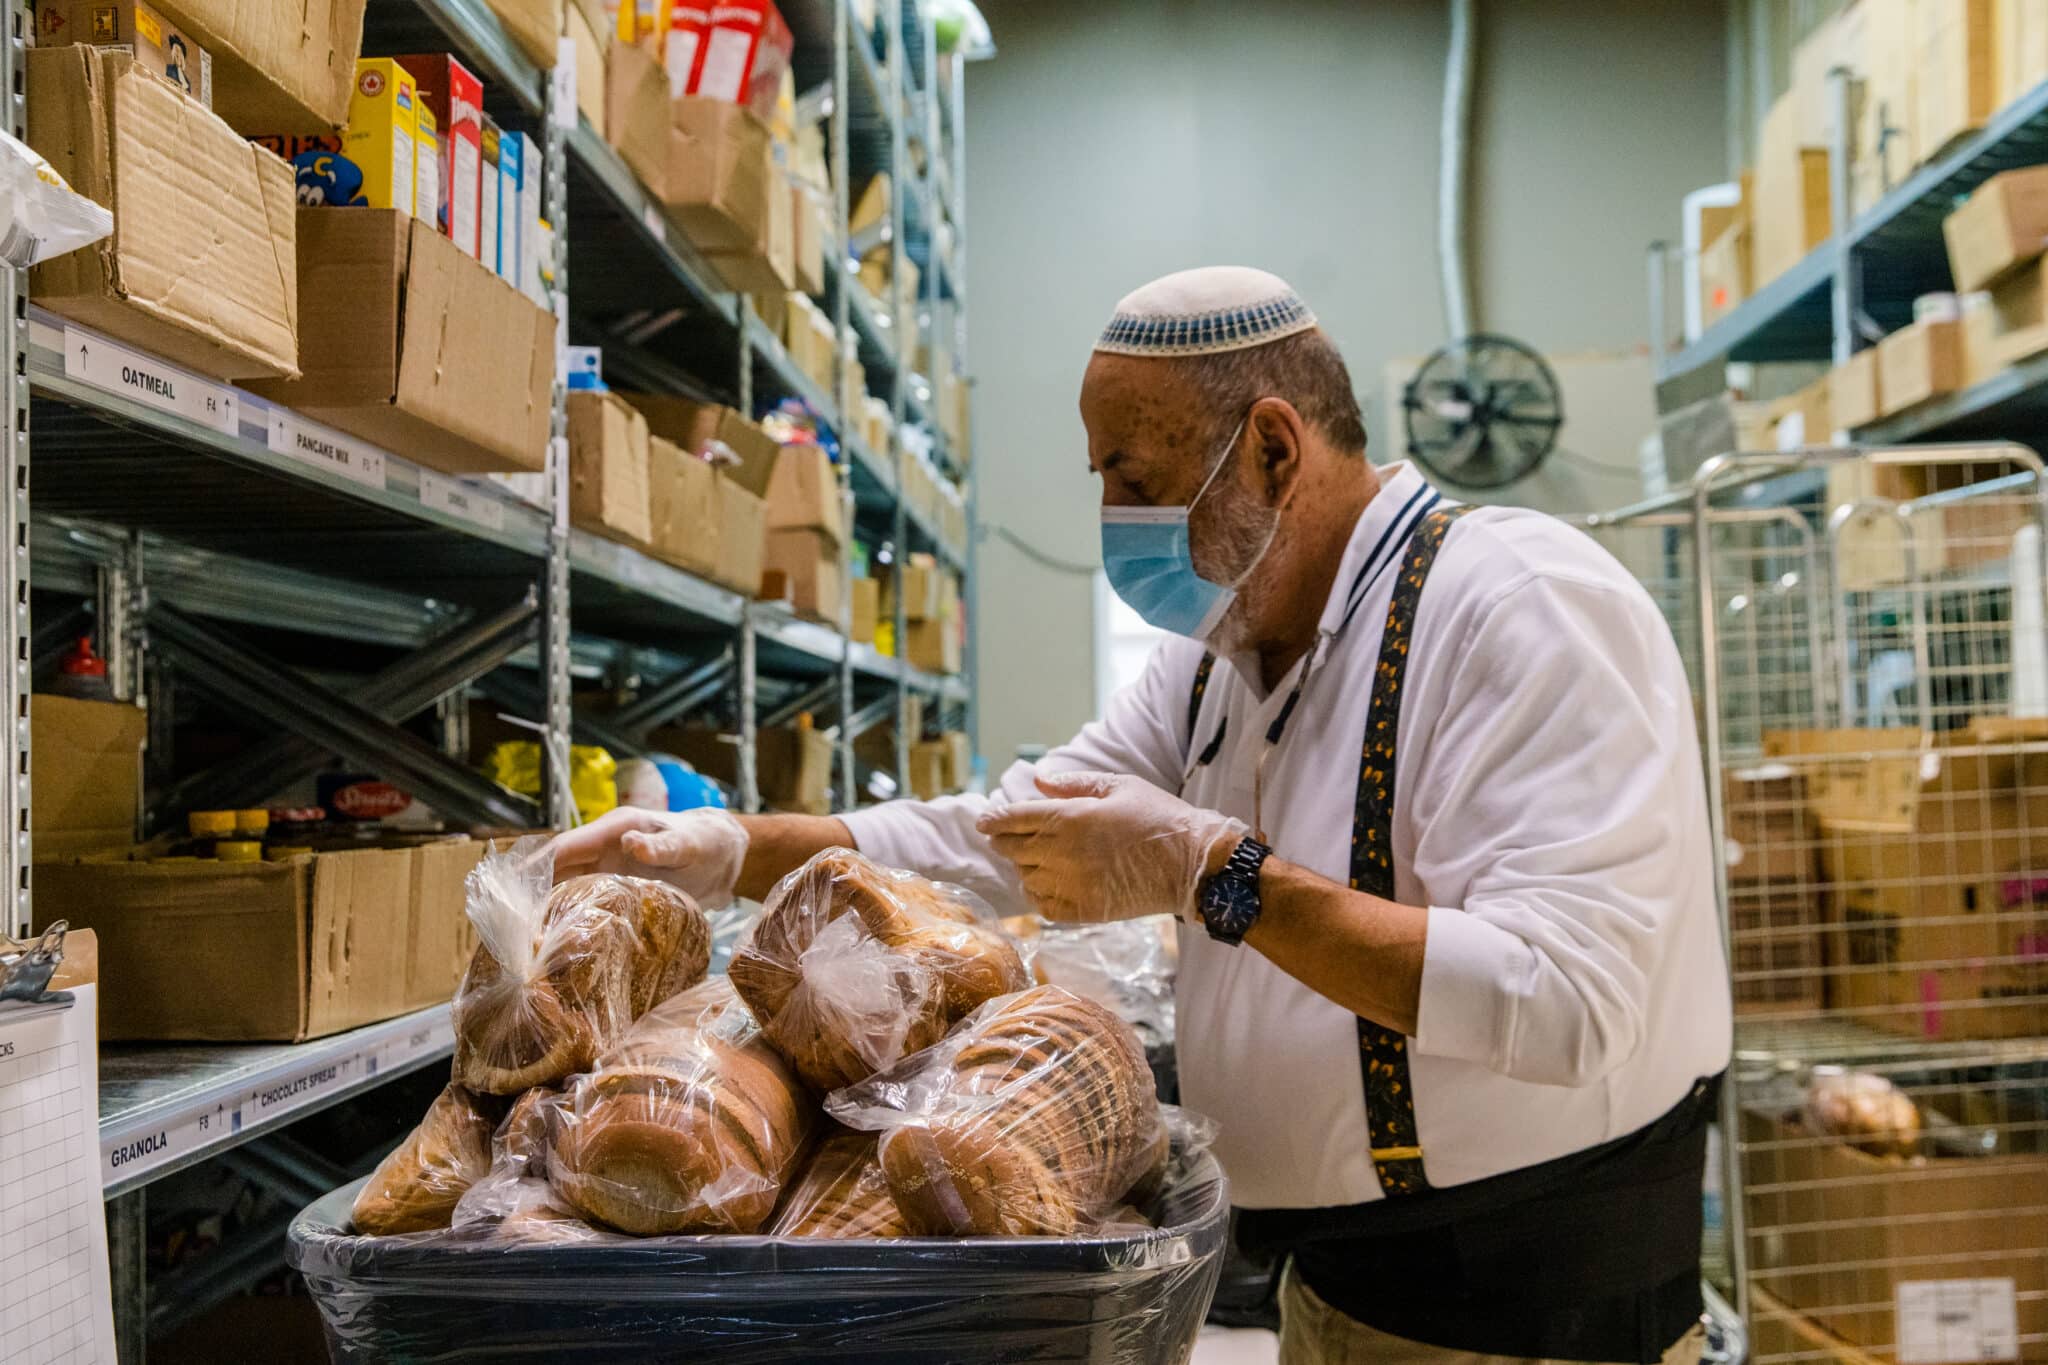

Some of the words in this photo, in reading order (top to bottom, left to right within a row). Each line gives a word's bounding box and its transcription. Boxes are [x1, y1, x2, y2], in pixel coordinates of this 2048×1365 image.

[122, 366, 175, 400] OATMEAL
[207, 397, 216, 412] F4
[297, 433, 333, 459] PANCAKE
[335, 447, 348, 465] MIX
[261, 1077, 307, 1107] CHOCOLATE
[309, 1066, 336, 1088] SPREAD
[111, 1131, 167, 1167] GRANOLA
